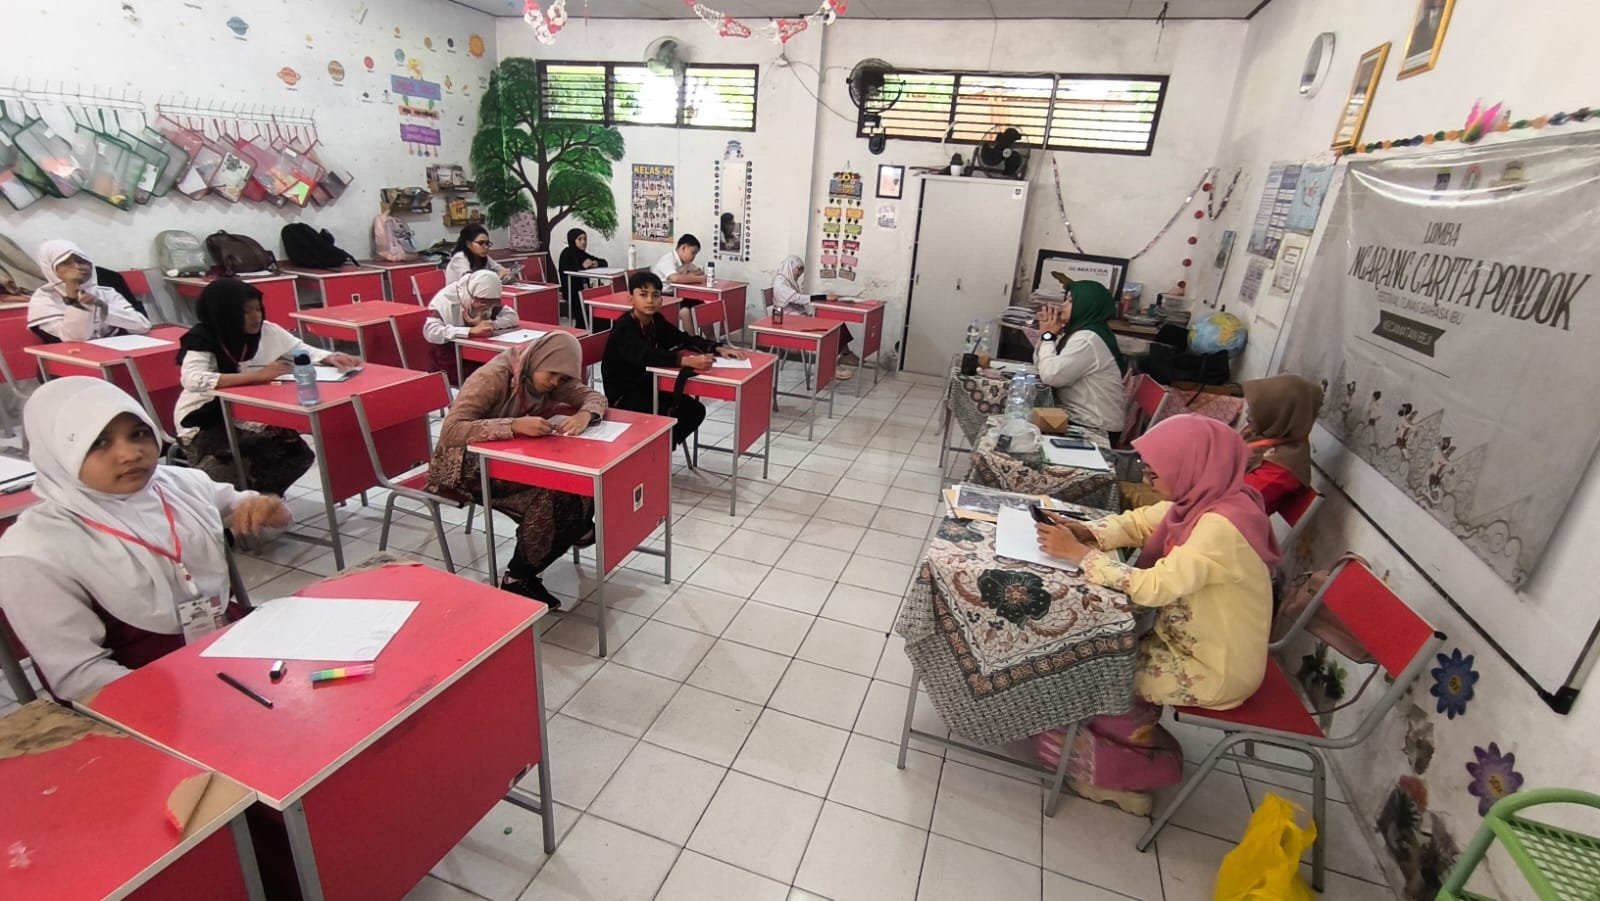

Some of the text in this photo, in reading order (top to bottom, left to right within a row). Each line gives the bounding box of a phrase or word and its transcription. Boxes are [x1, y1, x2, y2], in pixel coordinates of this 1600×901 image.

[633, 165, 673, 176] KELAS 4C
[1423, 221, 1462, 247] LOMBA
[1347, 245, 1417, 291] NGARANG
[1410, 252, 1484, 307] CARITA
[1475, 262, 1592, 331] PONDOK
[1419, 302, 1449, 320] BAHASA
[1449, 311, 1465, 325] IBU
